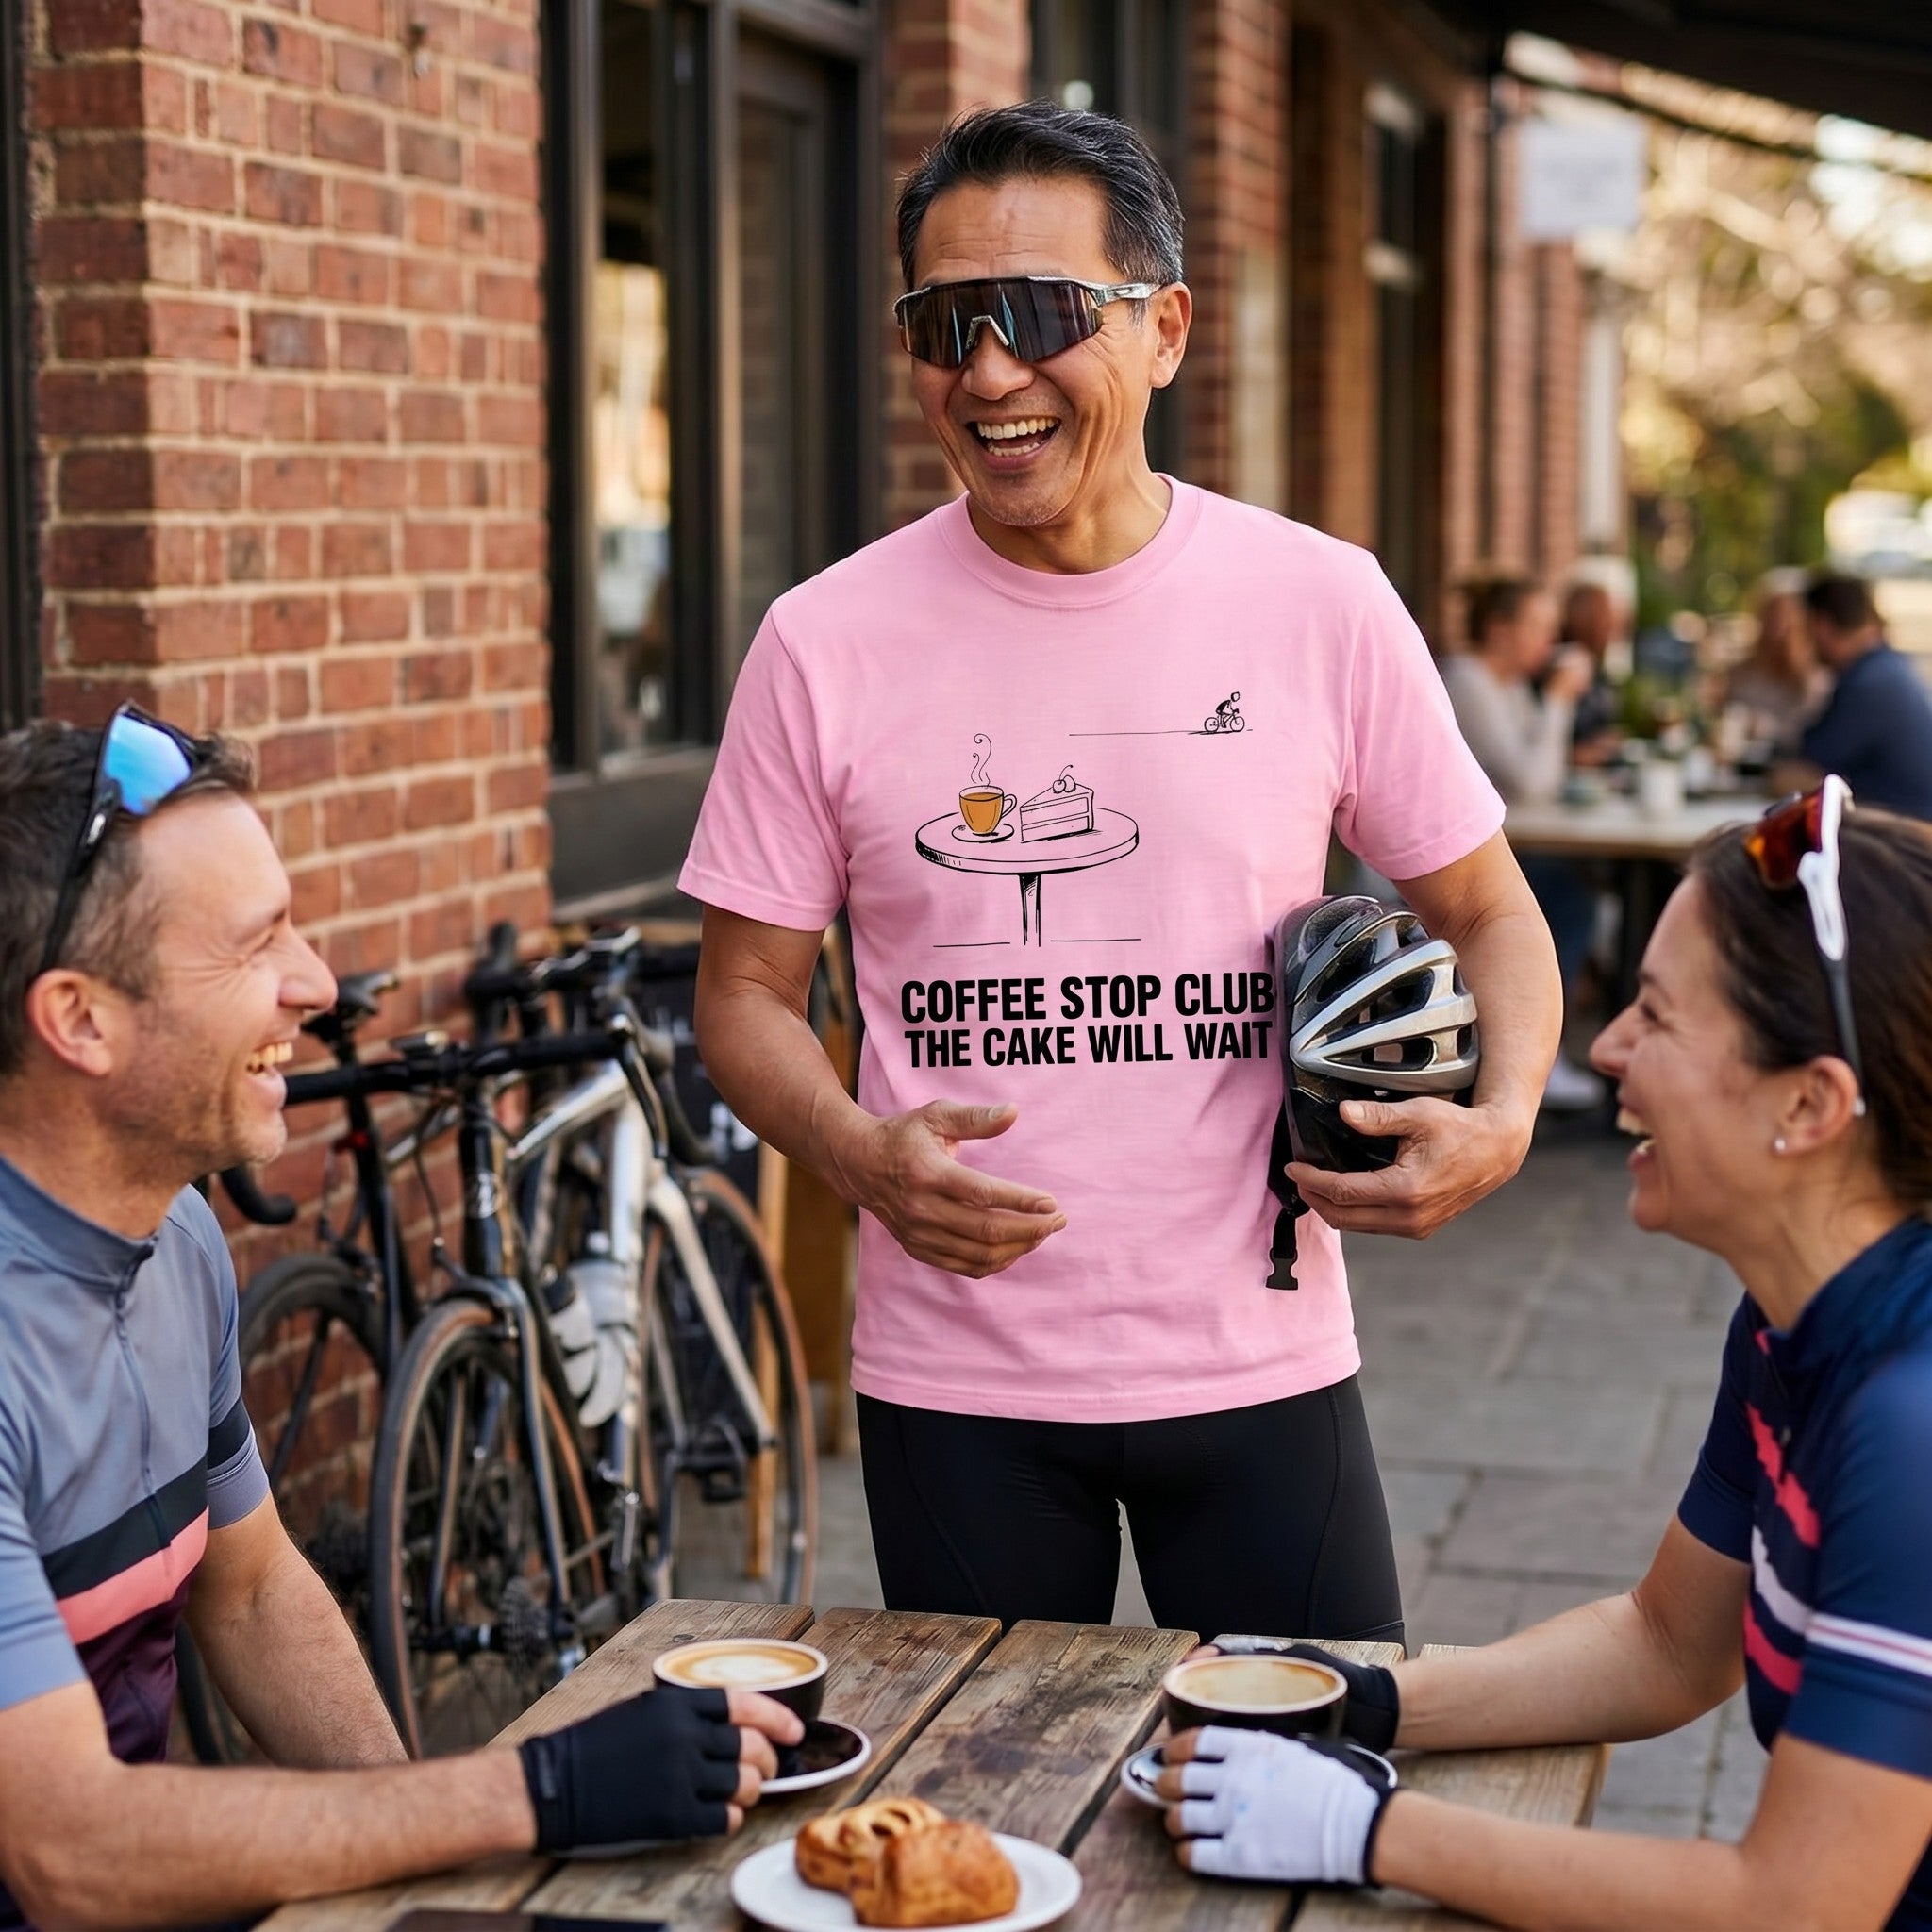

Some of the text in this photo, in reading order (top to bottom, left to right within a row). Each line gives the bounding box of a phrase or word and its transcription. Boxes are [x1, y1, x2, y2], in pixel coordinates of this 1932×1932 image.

[901, 972, 1274, 1024] COFFEE STOP CLUB
[904, 1021, 1274, 1068] THE CAKE WILL WAIT
